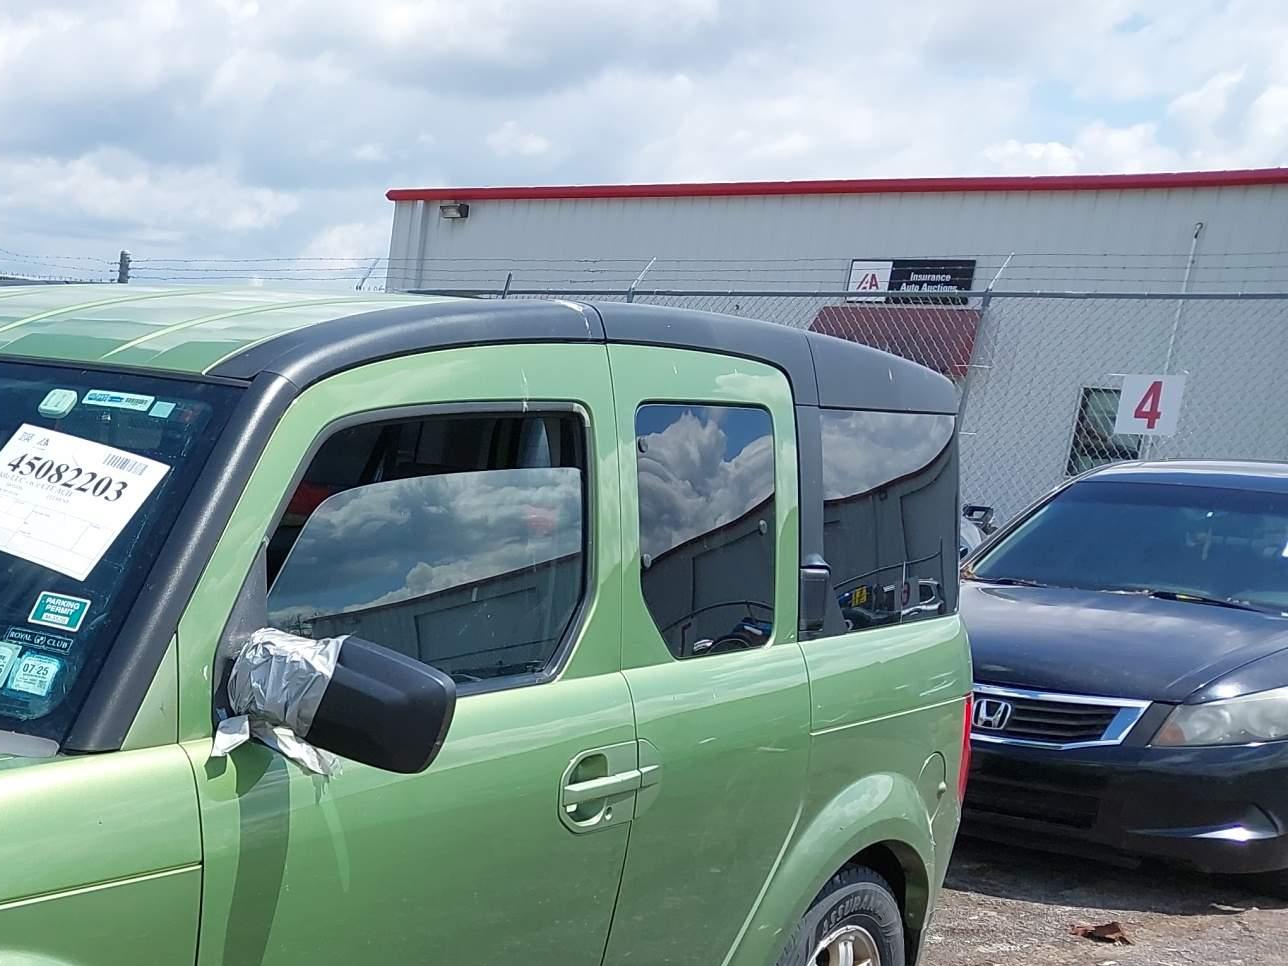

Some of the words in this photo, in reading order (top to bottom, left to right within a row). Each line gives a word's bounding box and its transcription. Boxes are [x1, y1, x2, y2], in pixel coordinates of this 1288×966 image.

[910, 271, 952, 282] Insurance
[900, 283, 920, 292] Auto
[921, 283, 958, 292] Auctions
[1134, 380, 1163, 429] 4
[8, 453, 128, 502] 45082203
[45, 597, 80, 610] PARKING
[45, 604, 75, 616] PERMIT
[9, 631, 32, 641] ROYAL
[47, 638, 68, 649] CLUB
